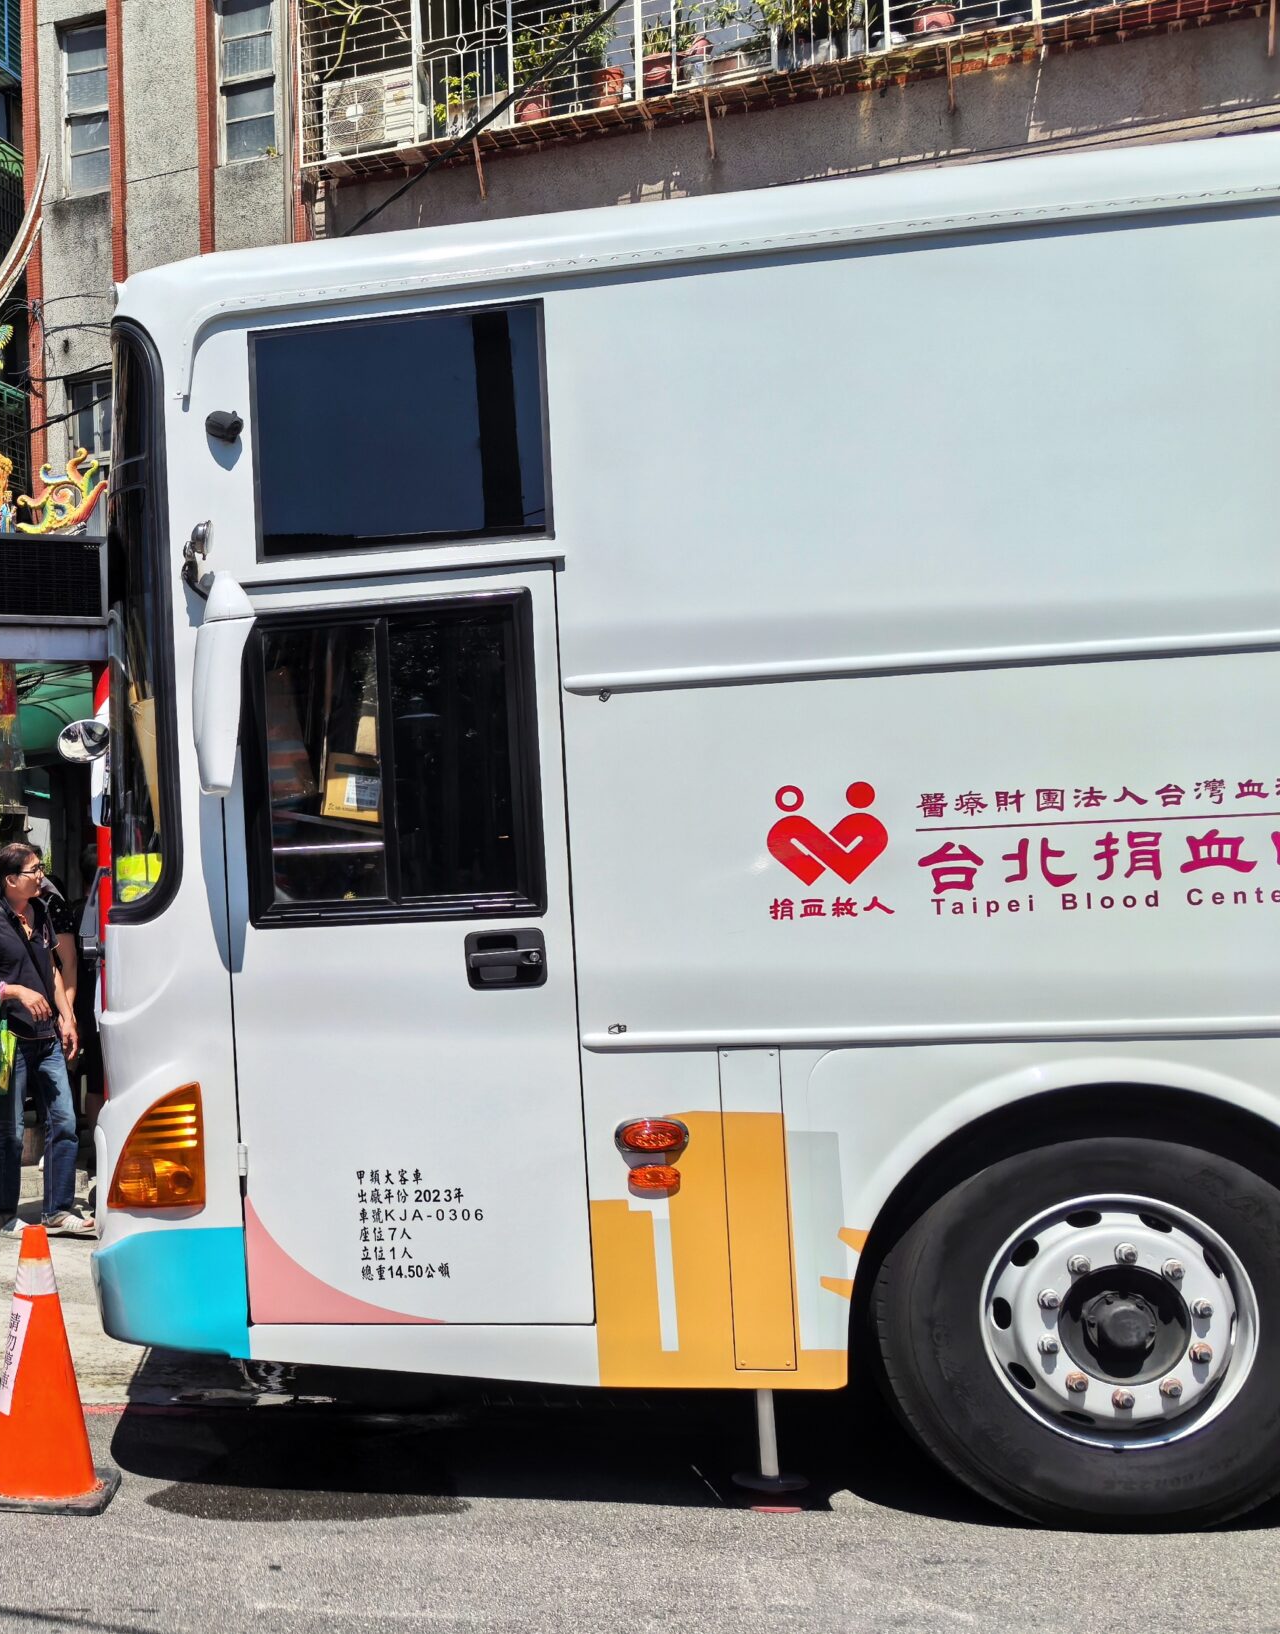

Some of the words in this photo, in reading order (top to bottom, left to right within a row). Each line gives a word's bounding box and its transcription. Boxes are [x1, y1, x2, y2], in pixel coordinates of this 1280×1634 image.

[918, 829, 1280, 895] 台北捐血
[769, 896, 895, 920] 捐血救人
[931, 895, 1034, 917] Taipei
[1061, 890, 1159, 911] Blood
[356, 1168, 423, 1185] 甲類大客車
[358, 1188, 409, 1204] 出廠年份
[414, 1188, 464, 1204] 2023年
[359, 1227, 412, 1242] 座位7人
[361, 1246, 413, 1261] 立位1人
